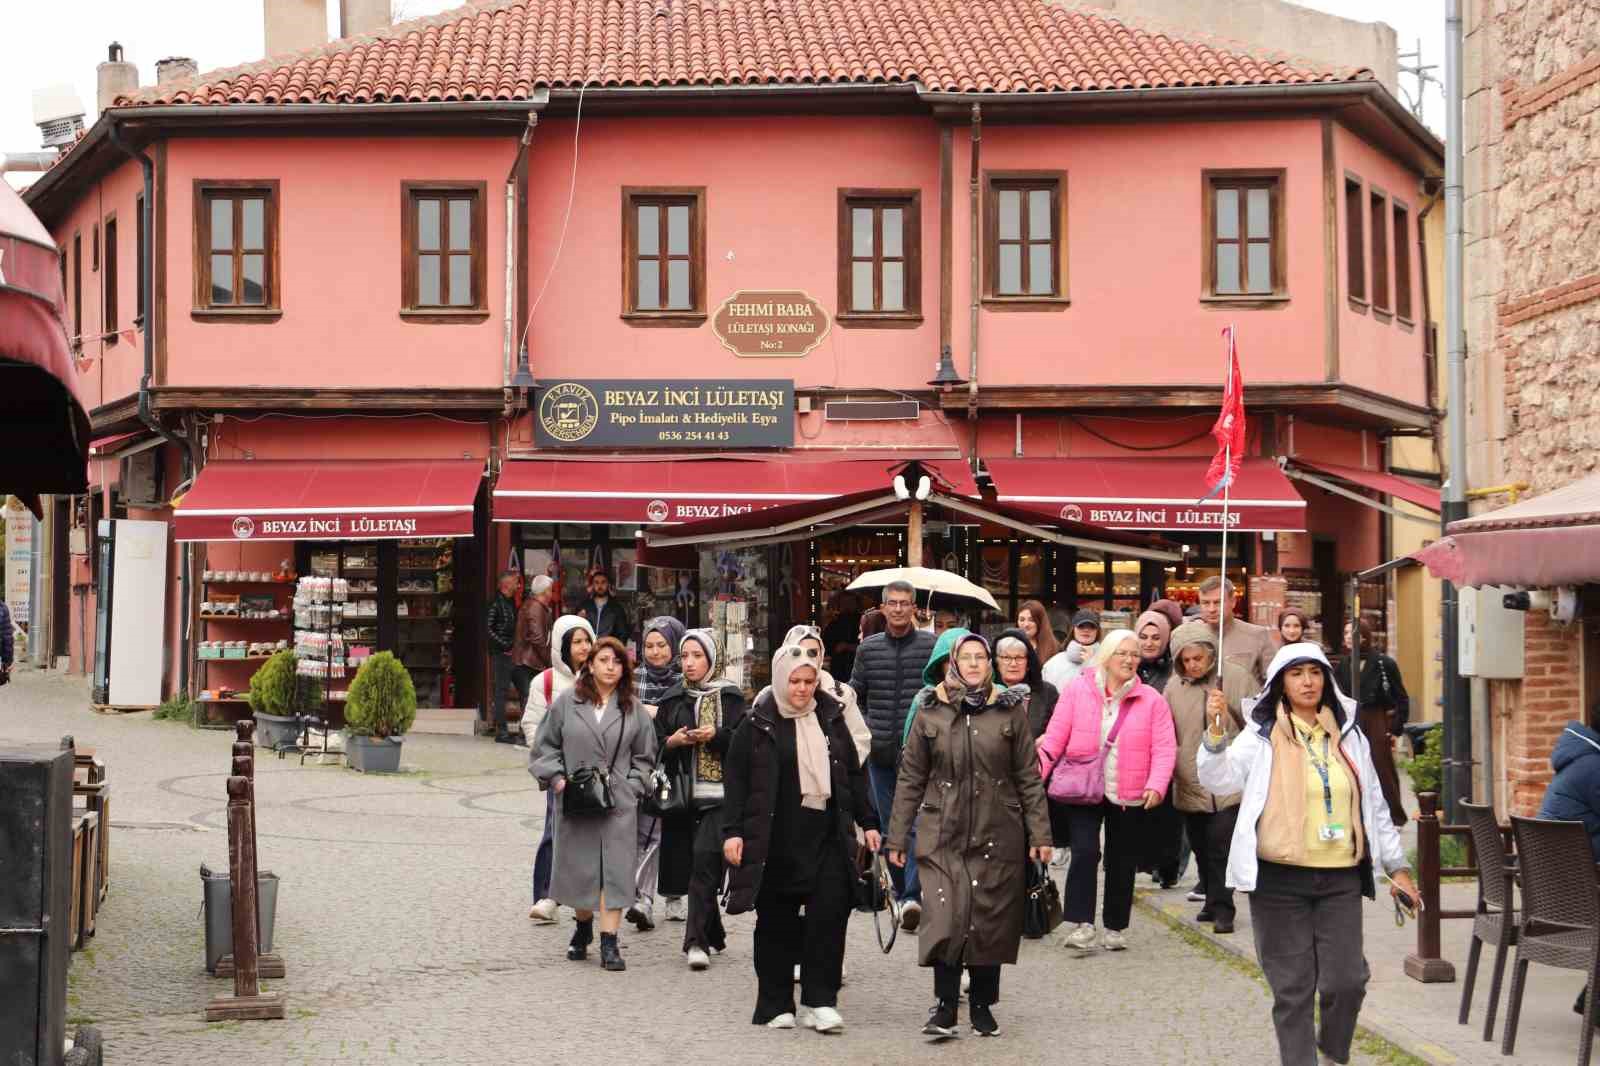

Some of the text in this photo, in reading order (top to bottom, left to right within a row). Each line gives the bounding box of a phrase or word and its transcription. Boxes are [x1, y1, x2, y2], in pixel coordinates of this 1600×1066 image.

[728, 300, 814, 317] FEHMİ BABA
[728, 321, 816, 336] LÜLETAŞI KONAĞI
[604, 386, 785, 410] BEYAZ İNCİ LÜLETAŞI
[610, 409, 778, 427] Pipo İmalatı & Hediyelik Eşya
[659, 431, 730, 441] 0536 254 41 43
[677, 505, 719, 518] BEYAZ
[1089, 509, 1134, 523] BEYAZ
[1136, 508, 1167, 524] İNCİ
[262, 520, 307, 534] BEYAZ
[309, 517, 340, 533] İNCİ
[351, 516, 417, 534] LÜLETAŞI
